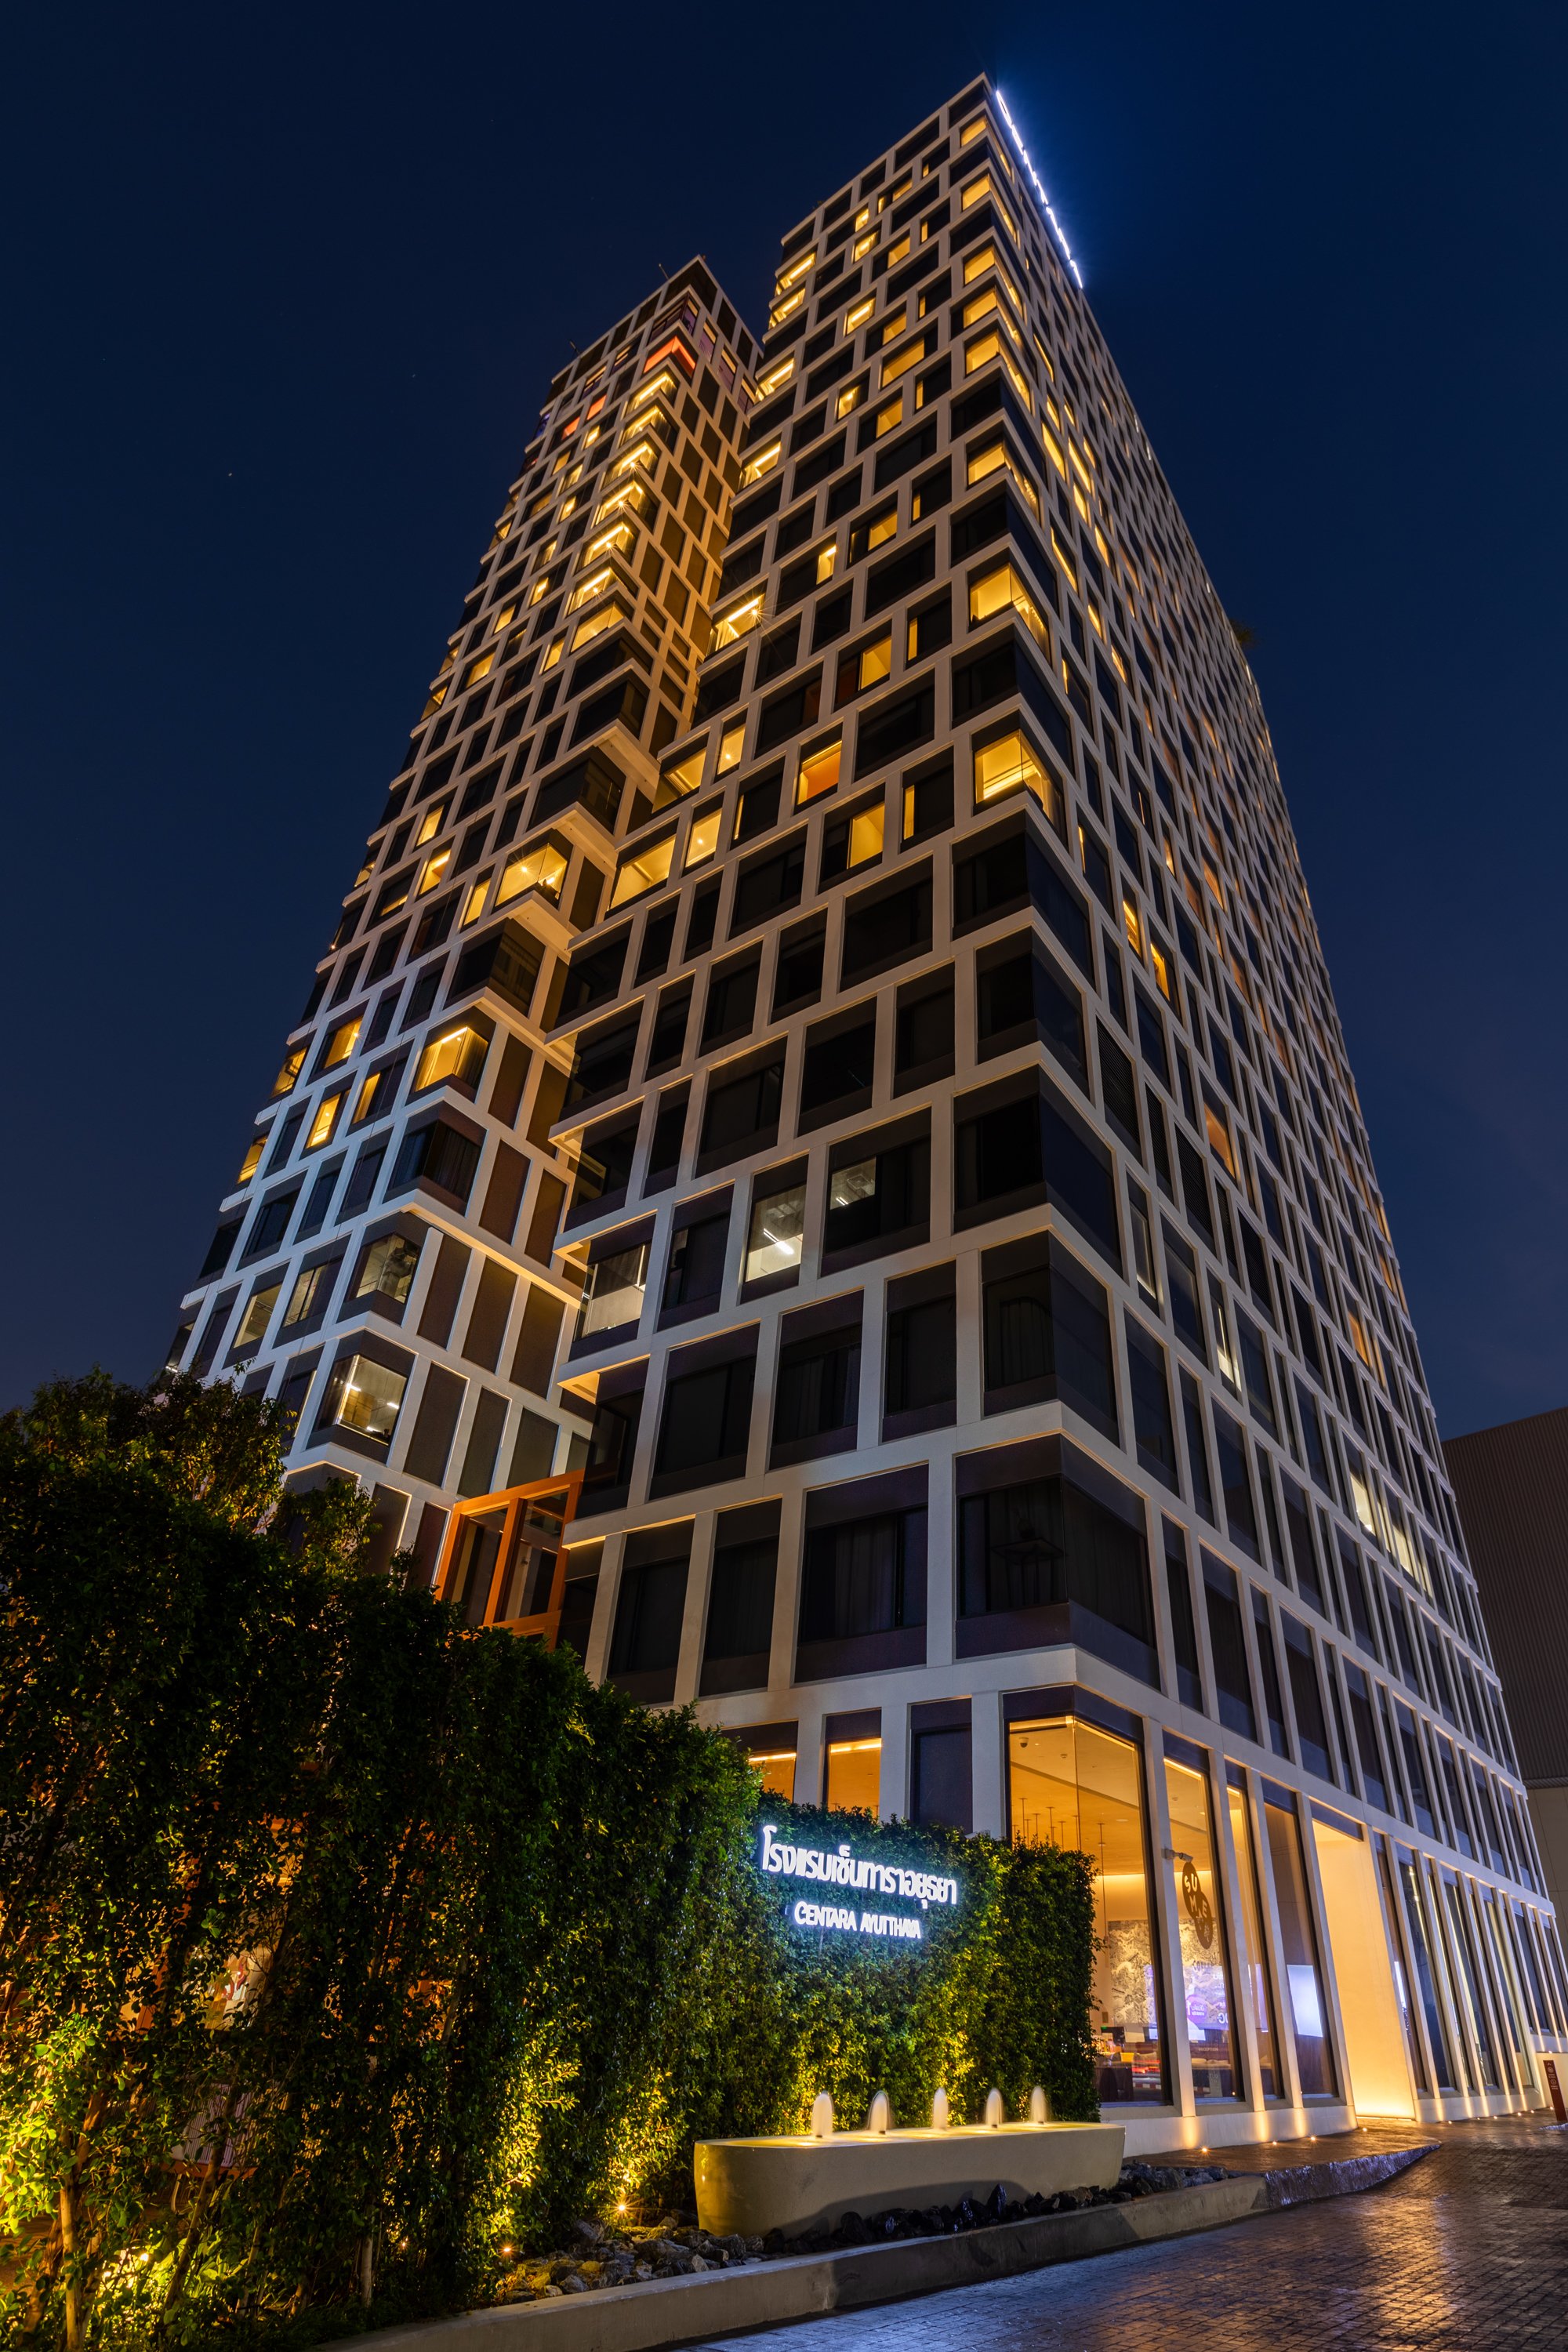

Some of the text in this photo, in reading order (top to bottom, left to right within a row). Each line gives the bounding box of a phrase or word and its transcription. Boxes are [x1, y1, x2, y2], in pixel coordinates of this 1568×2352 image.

[762, 1824, 956, 1909] โรงแรมเซ็นทาราอยุธยา
[794, 1900, 921, 1939] CENTARA AYUTTHAYA
